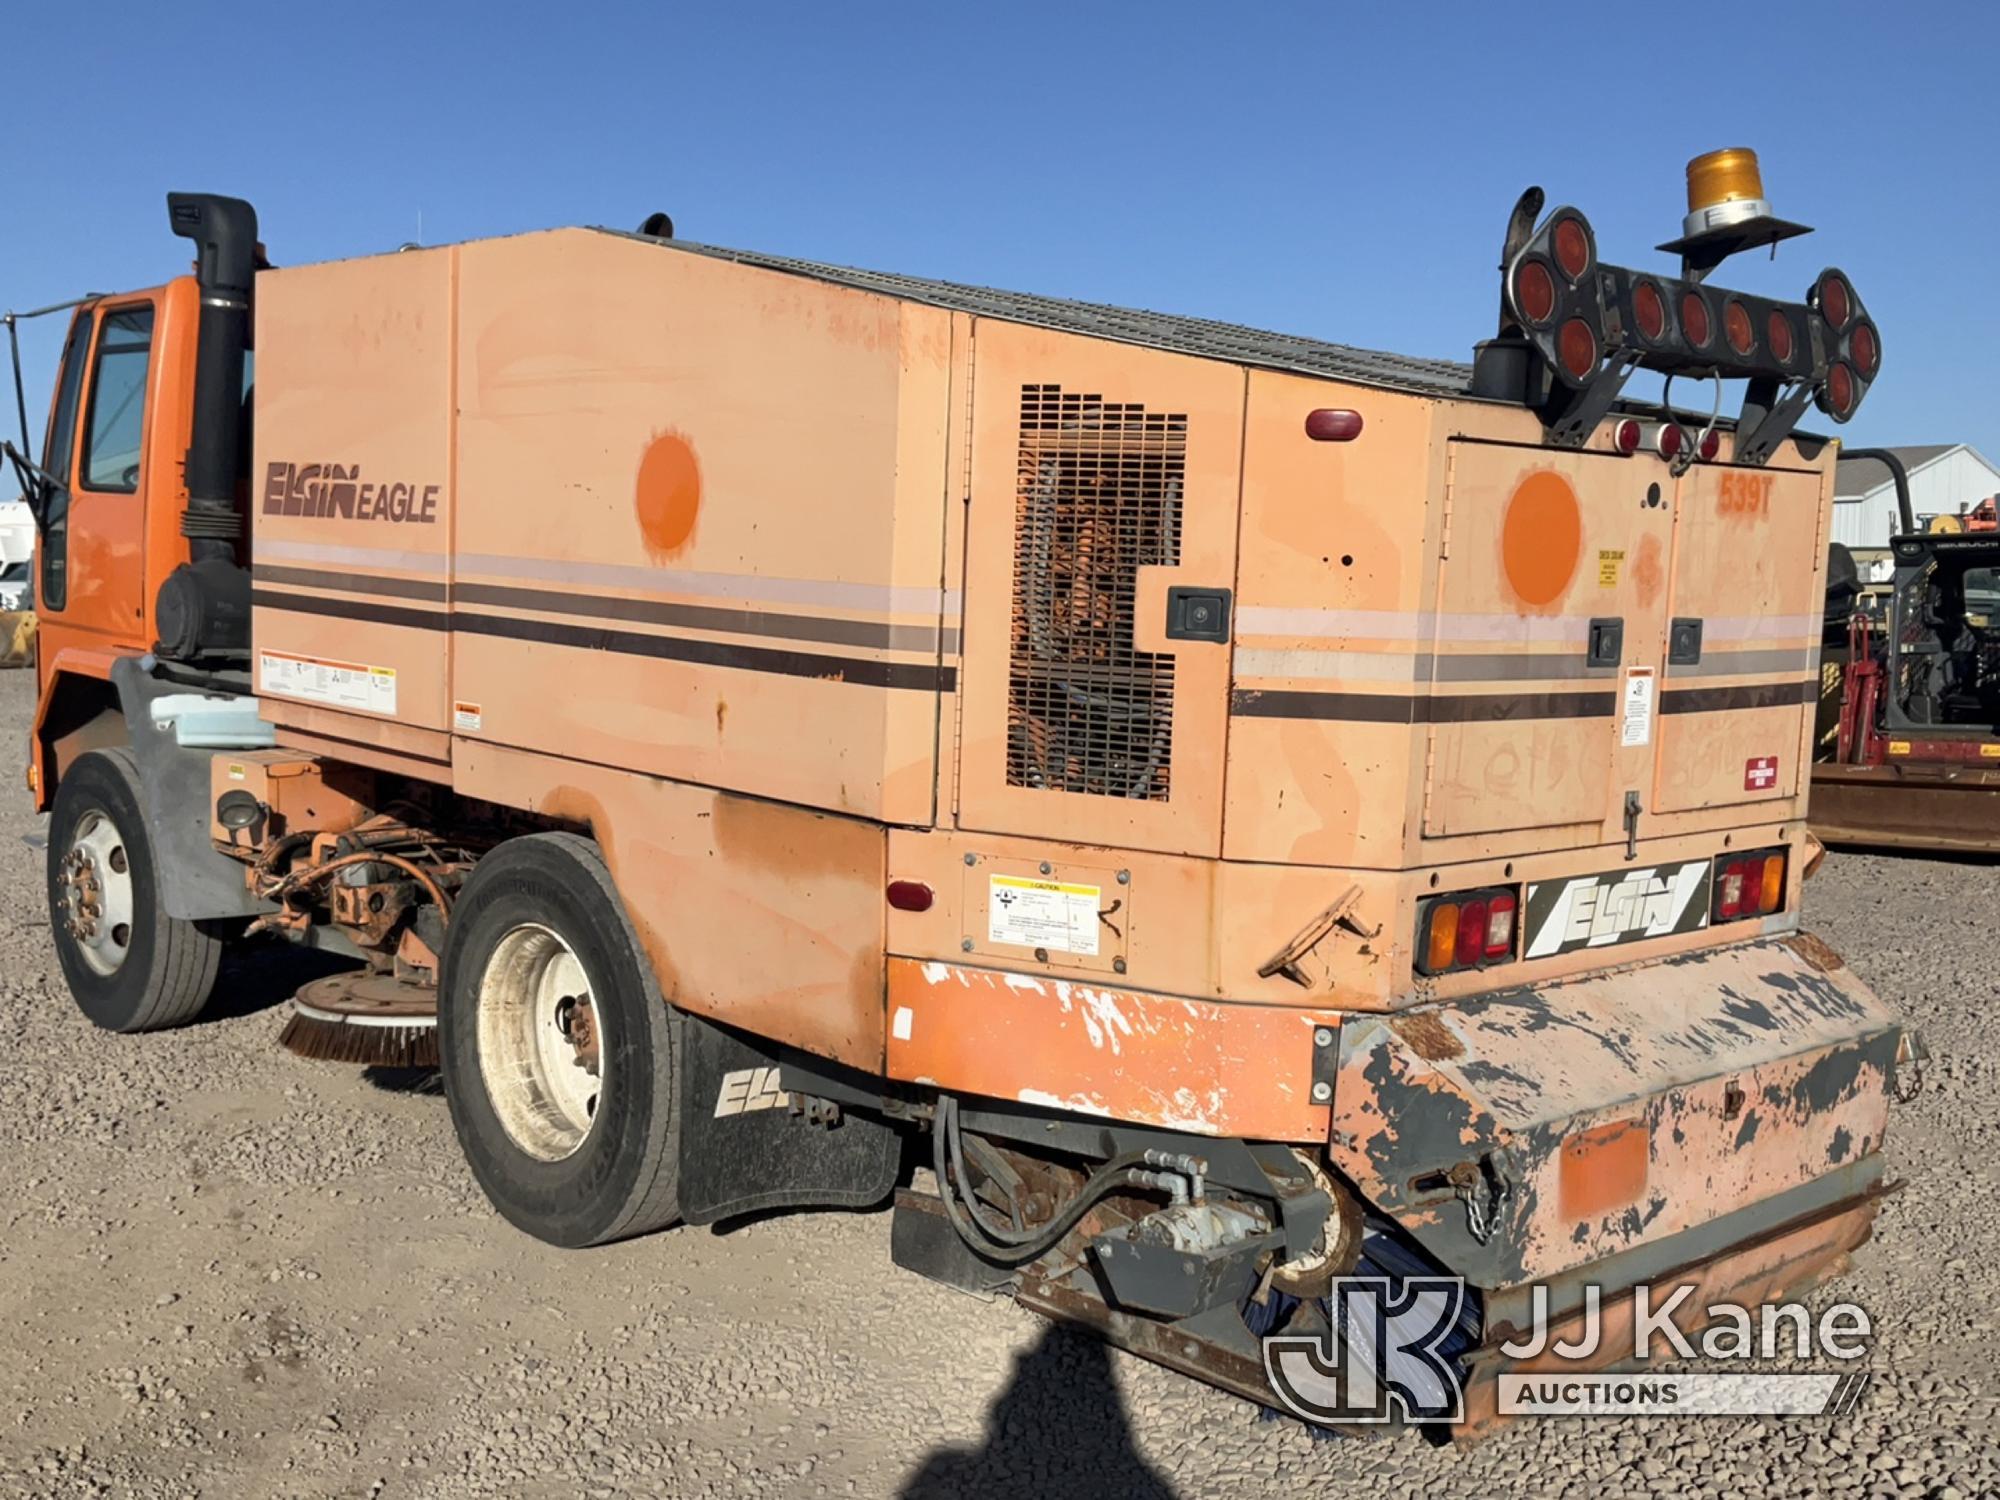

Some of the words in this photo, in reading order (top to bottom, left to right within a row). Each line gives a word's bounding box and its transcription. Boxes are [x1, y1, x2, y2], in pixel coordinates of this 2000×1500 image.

[262, 462, 359, 519] ELGIN
[357, 482, 439, 523] EAGLE
[1719, 472, 1773, 516] 539T
[1564, 874, 1679, 942] ELGIN
